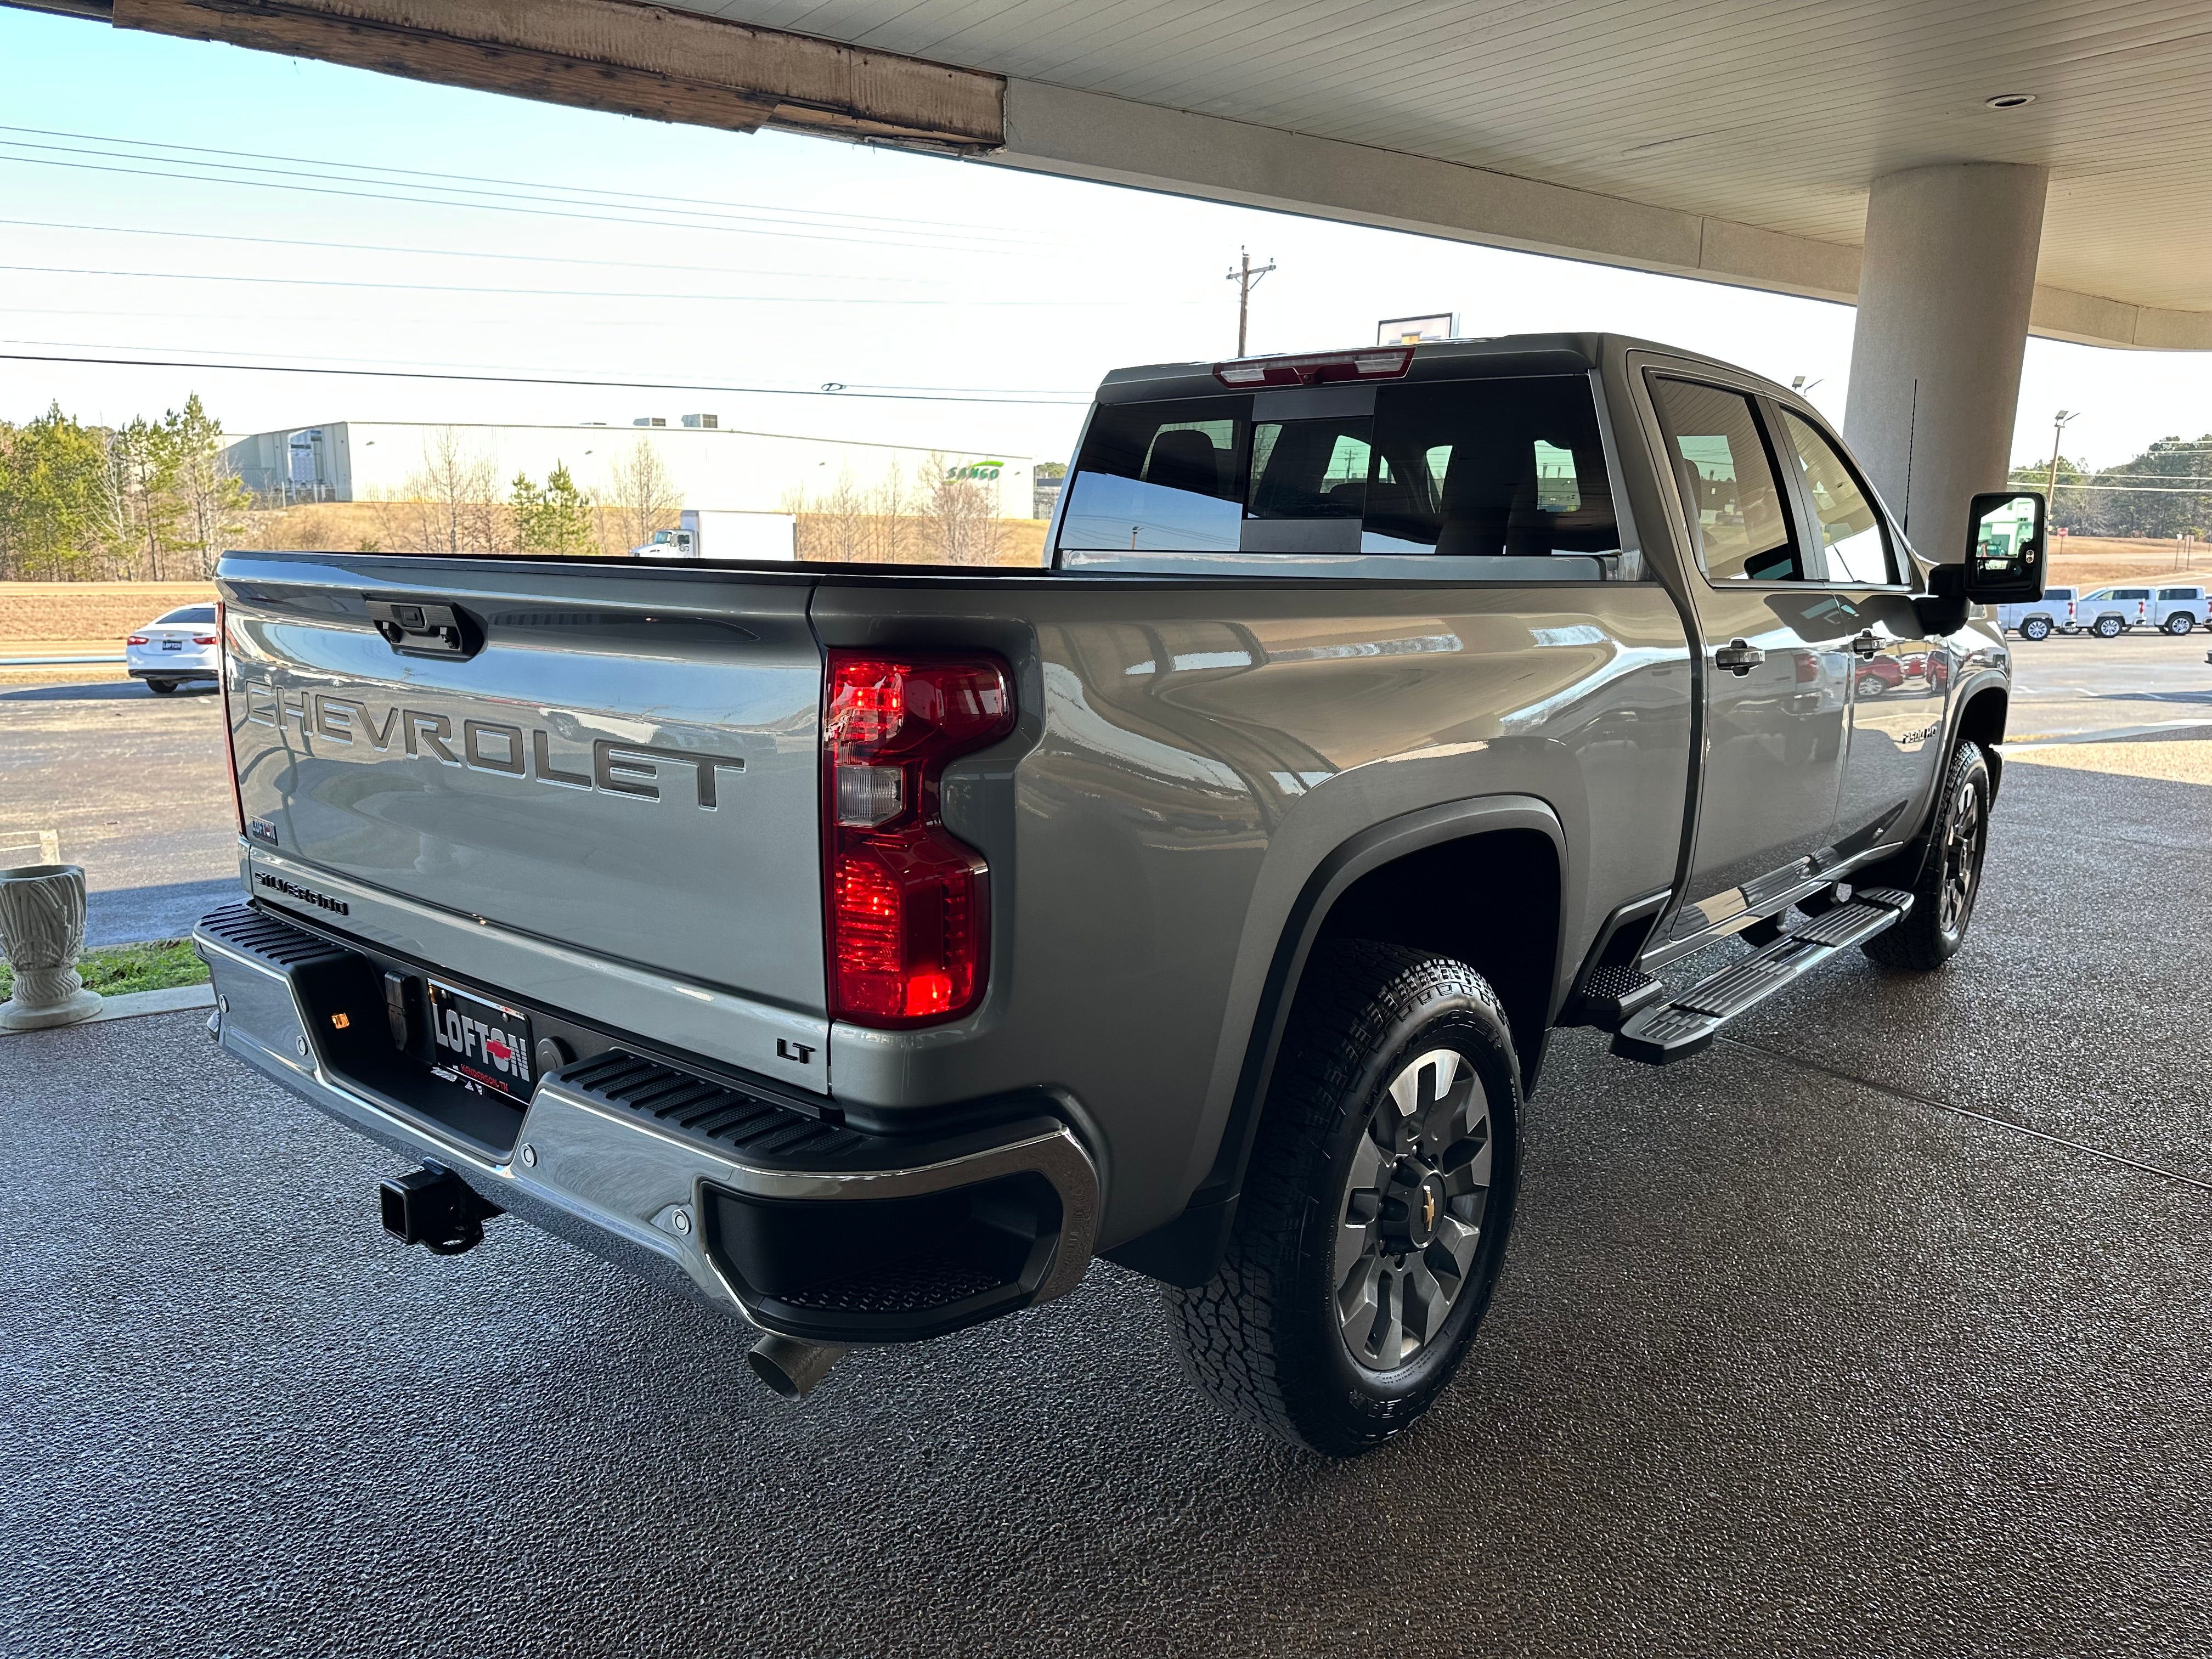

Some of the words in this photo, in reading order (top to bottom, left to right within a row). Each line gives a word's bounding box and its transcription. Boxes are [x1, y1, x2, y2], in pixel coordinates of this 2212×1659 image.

[945, 466, 1000, 481] SANGO
[246, 679, 746, 812] CHEVROLET
[254, 870, 349, 916] SILVERADO
[432, 1002, 530, 1082] LOFTON
[776, 1038, 816, 1064] LT
